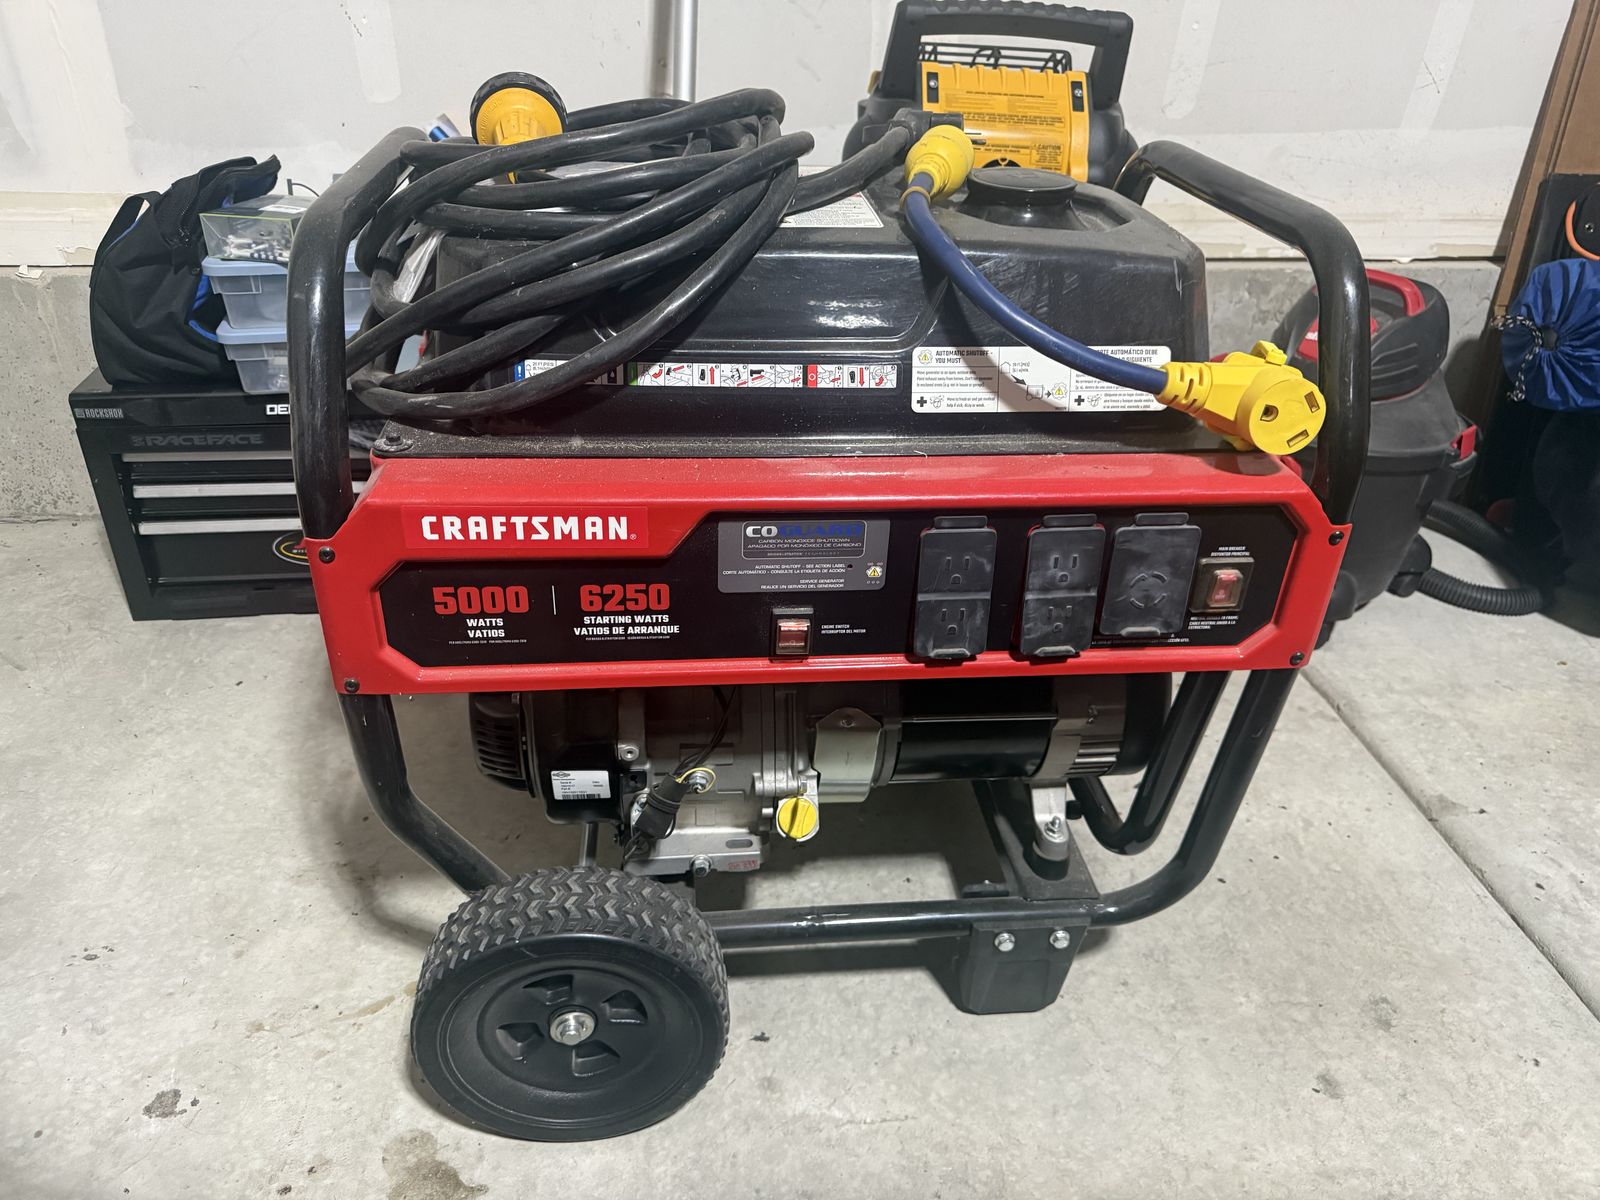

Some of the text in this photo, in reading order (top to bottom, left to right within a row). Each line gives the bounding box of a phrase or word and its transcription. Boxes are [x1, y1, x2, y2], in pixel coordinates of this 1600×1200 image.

[85, 408, 124, 418] ROCKSHOX
[420, 516, 628, 541] CRAFTSMAN
[432, 586, 530, 615] 5000
[580, 584, 670, 612] 6250
[466, 618, 504, 627] WATTS
[583, 614, 670, 624] STARTING WATTS
[467, 629, 506, 638] VATIOS
[573, 625, 680, 636] VATIOS DE ARRANQUE
